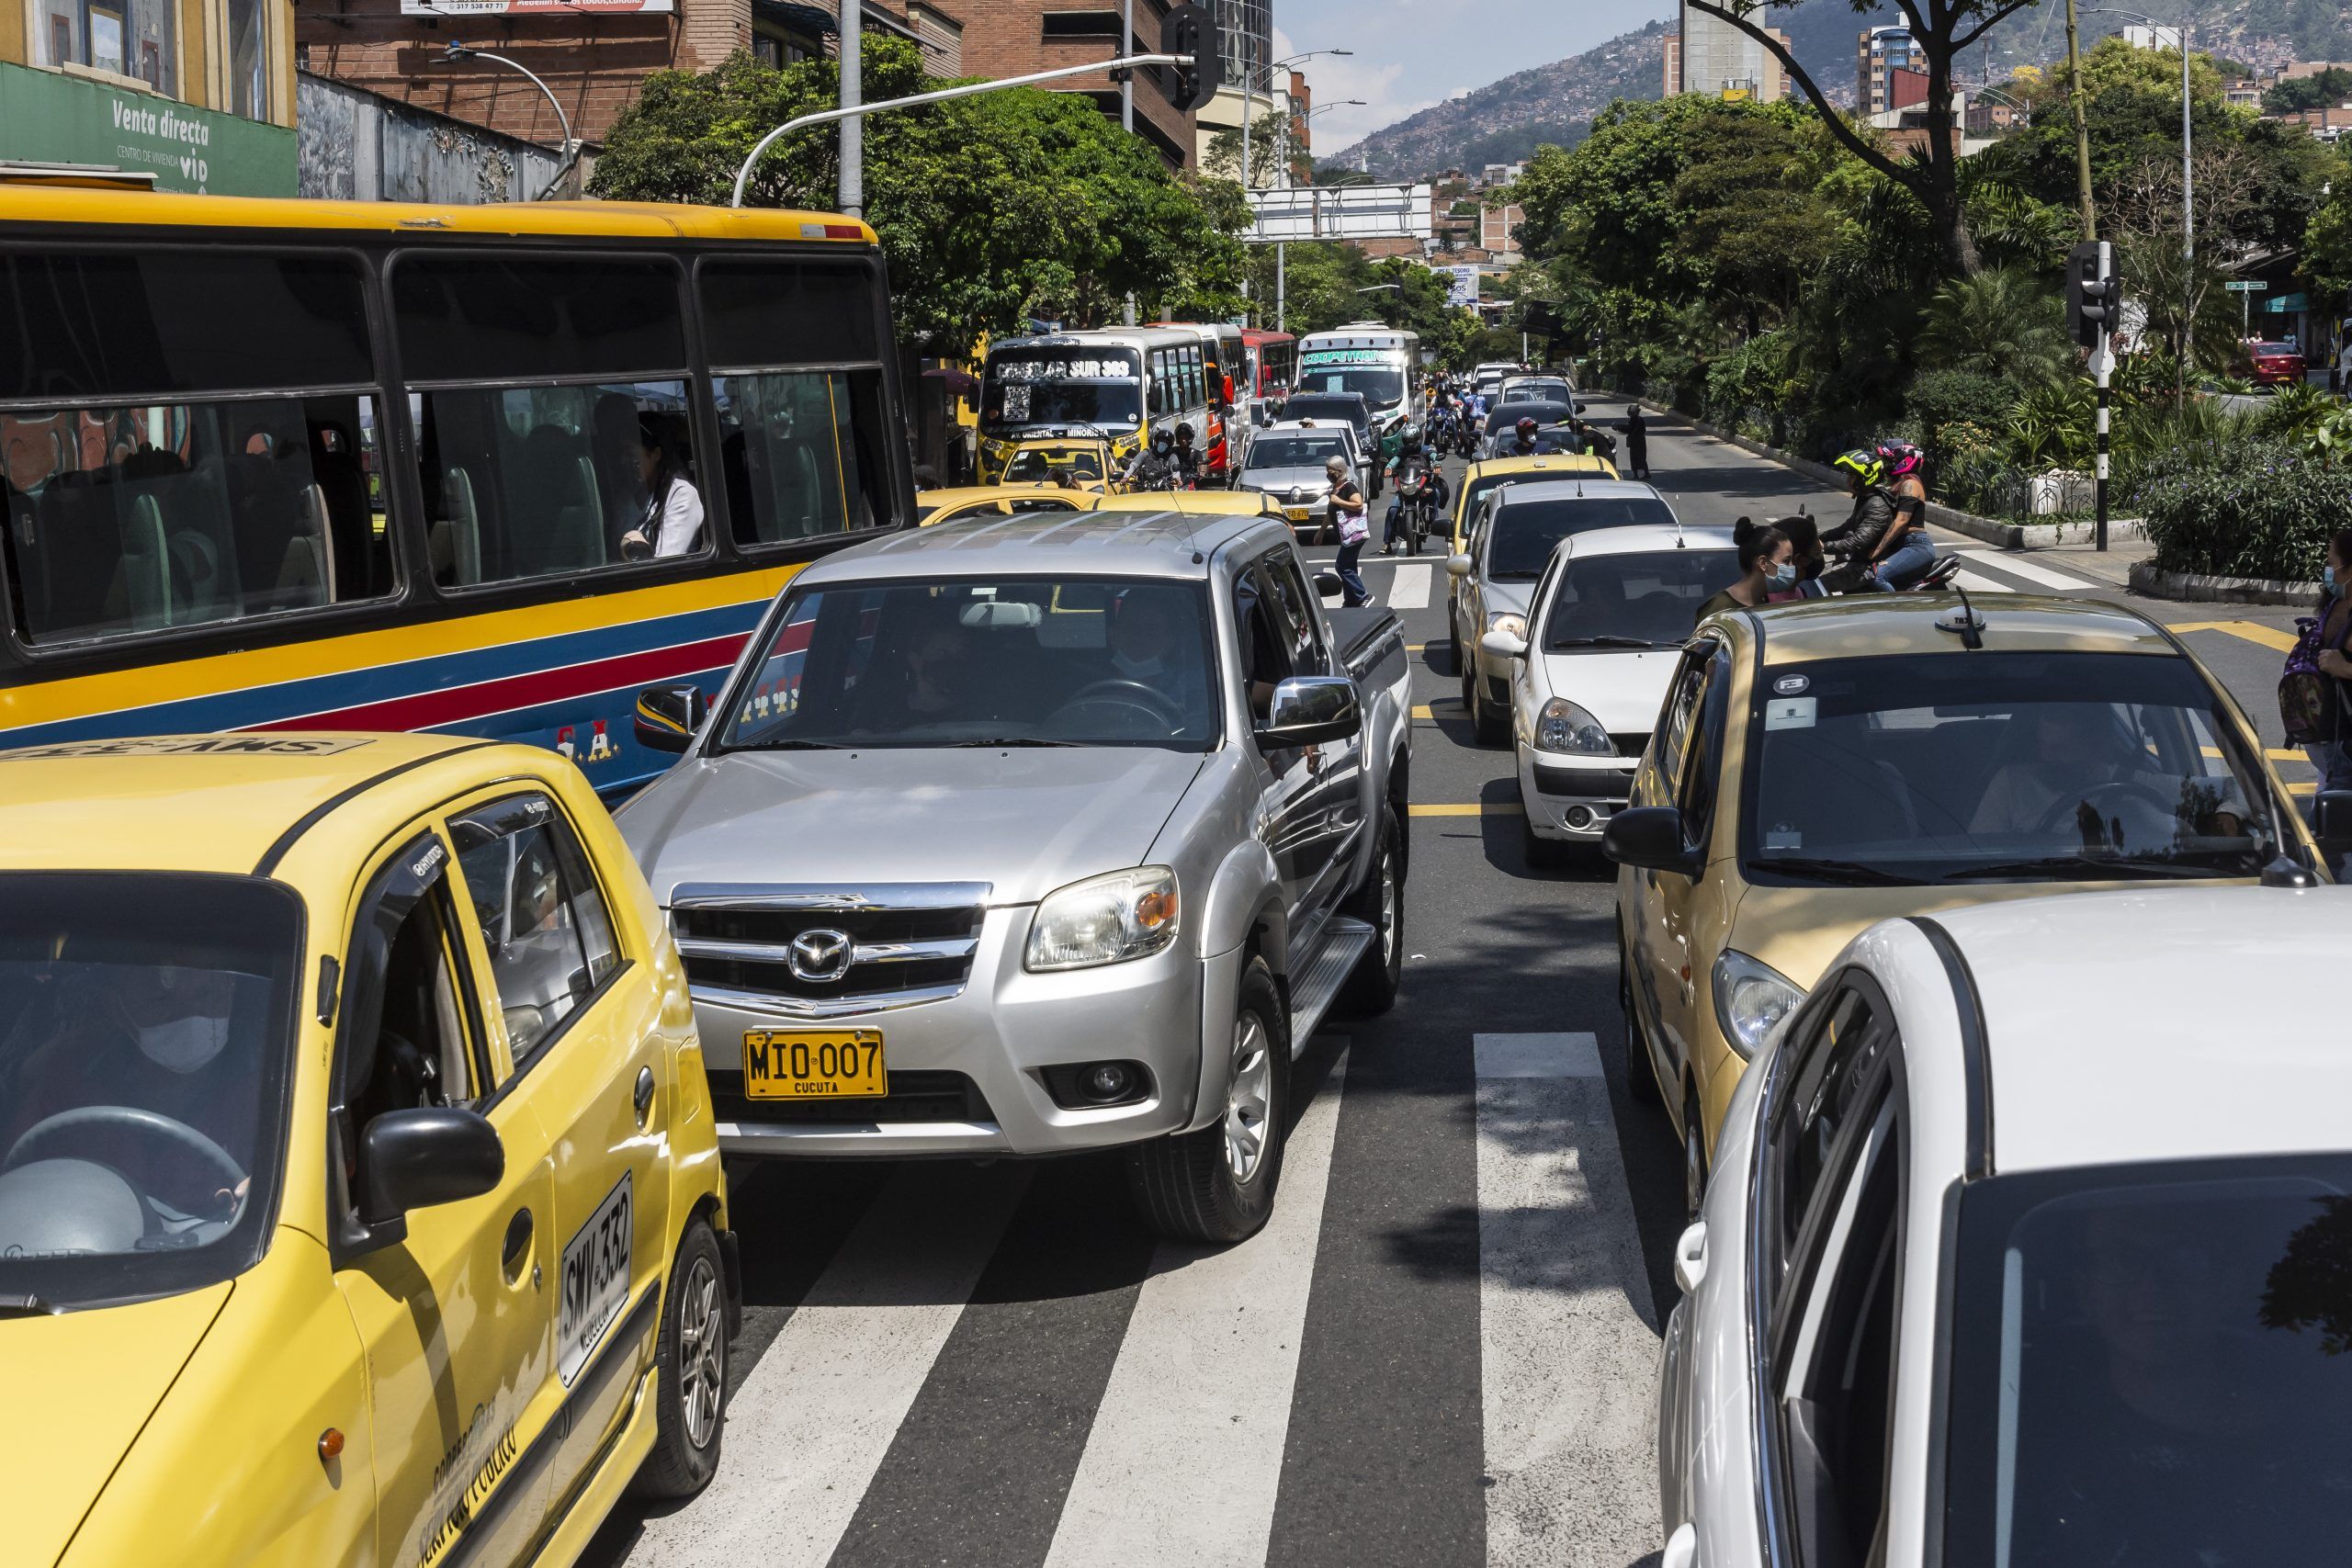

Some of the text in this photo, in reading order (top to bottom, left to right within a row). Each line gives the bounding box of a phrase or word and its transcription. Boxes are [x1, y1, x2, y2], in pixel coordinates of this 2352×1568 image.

[113, 99, 209, 146] Venta directa
[117, 144, 142, 163] CENTRO
[142, 150, 152, 164] DE
[152, 152, 179, 167] VIVIENDA
[1069, 360, 1101, 378] SUR
[1022, 429, 1055, 439] ORIENTAL
[1067, 428, 1109, 438] MINORISTA
[1954, 616, 1972, 625] TAX
[794, 1081, 839, 1093] CUCUTA
[579, 1297, 610, 1355] MEDELLIN
